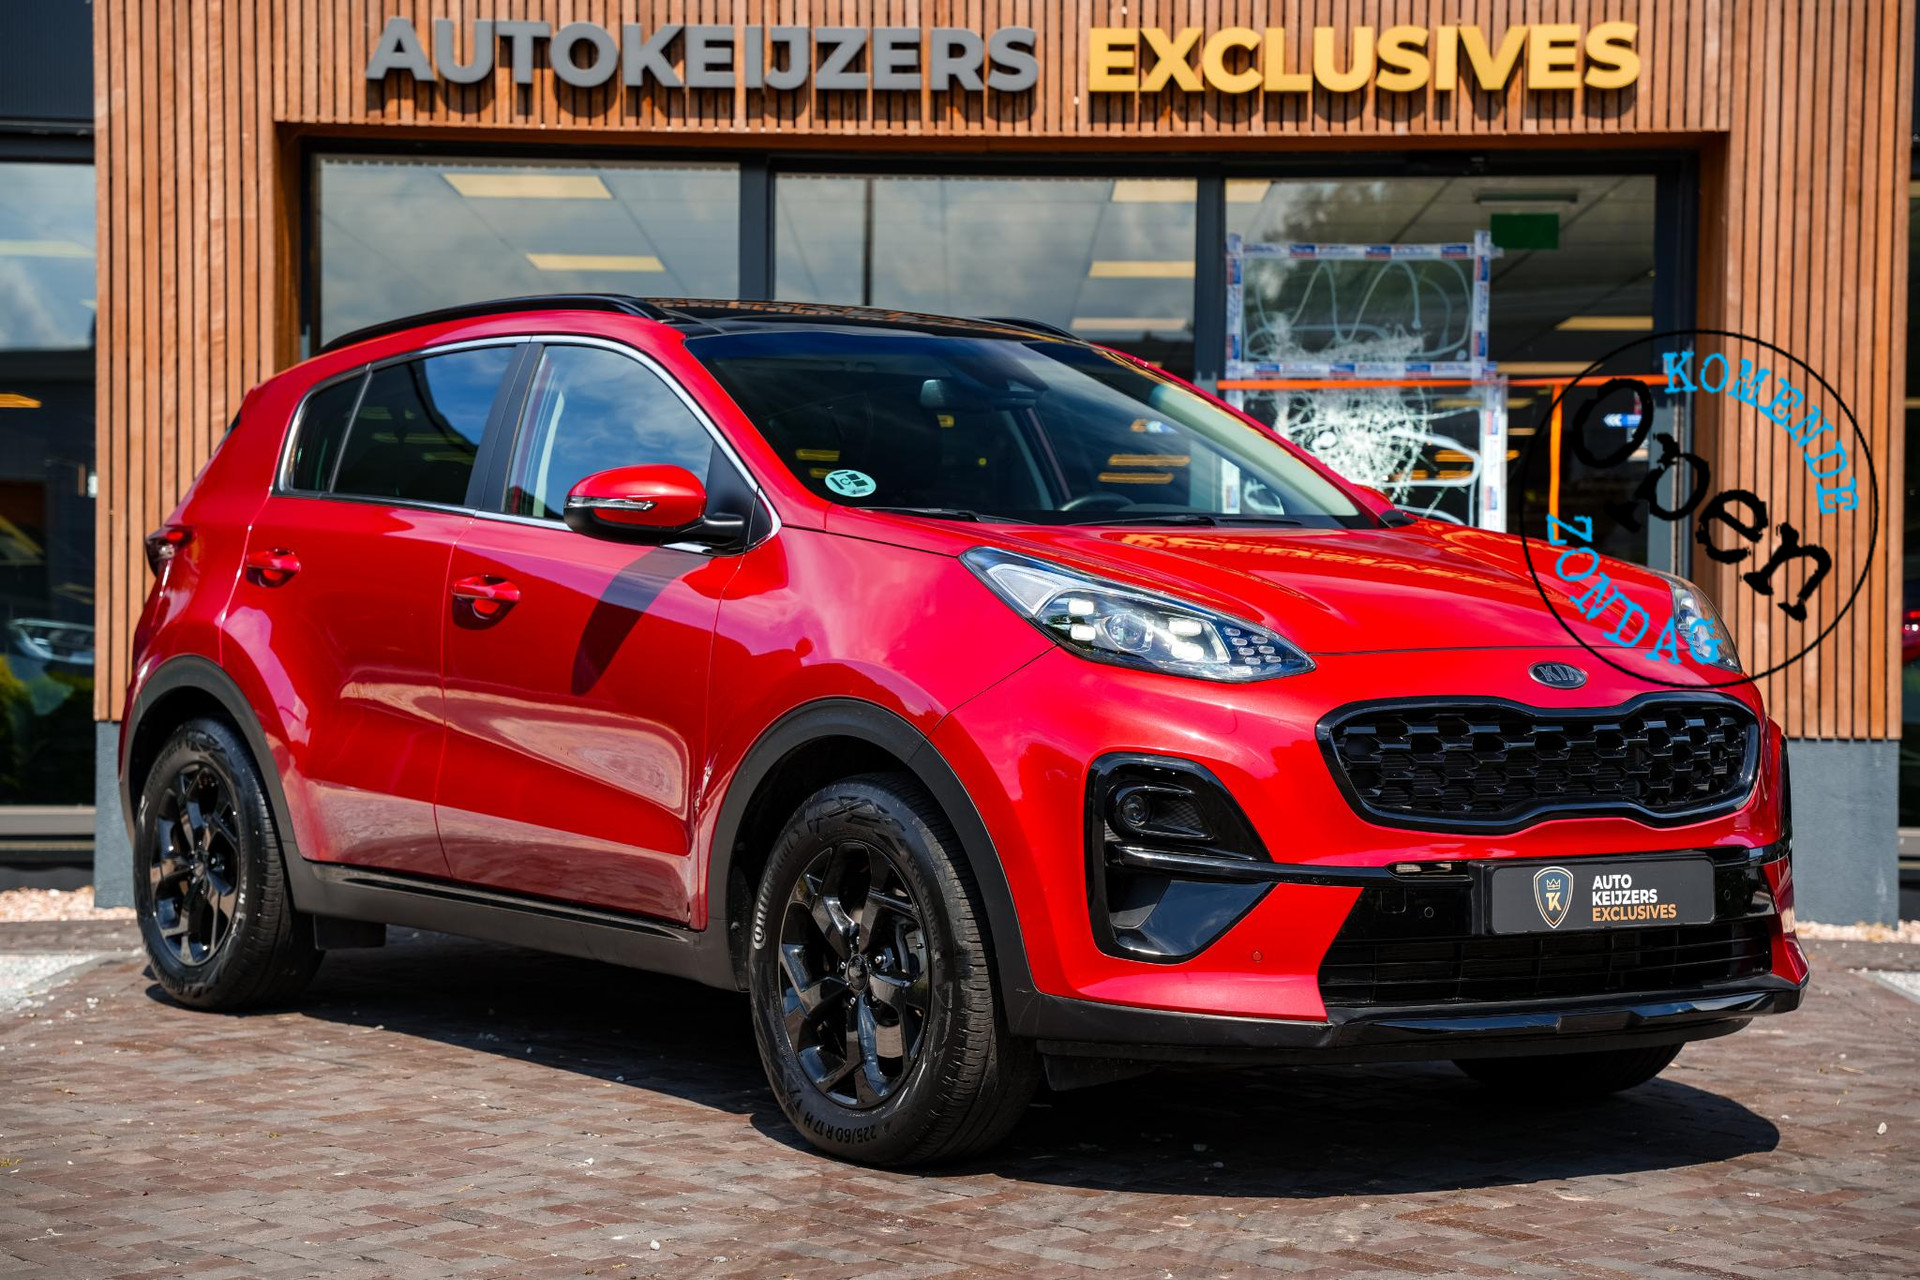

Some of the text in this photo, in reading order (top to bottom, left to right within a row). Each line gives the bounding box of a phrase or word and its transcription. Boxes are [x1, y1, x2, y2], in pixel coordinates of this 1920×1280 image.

[366, 18, 1639, 93] AUTOKEIJZERS EXCLUSIVES
[1537, 664, 1582, 684] KIA
[1592, 874, 1632, 891] AUTO
[1592, 889, 1658, 907] KEIJZERS
[1592, 903, 1678, 922] EXCLUSIVES
